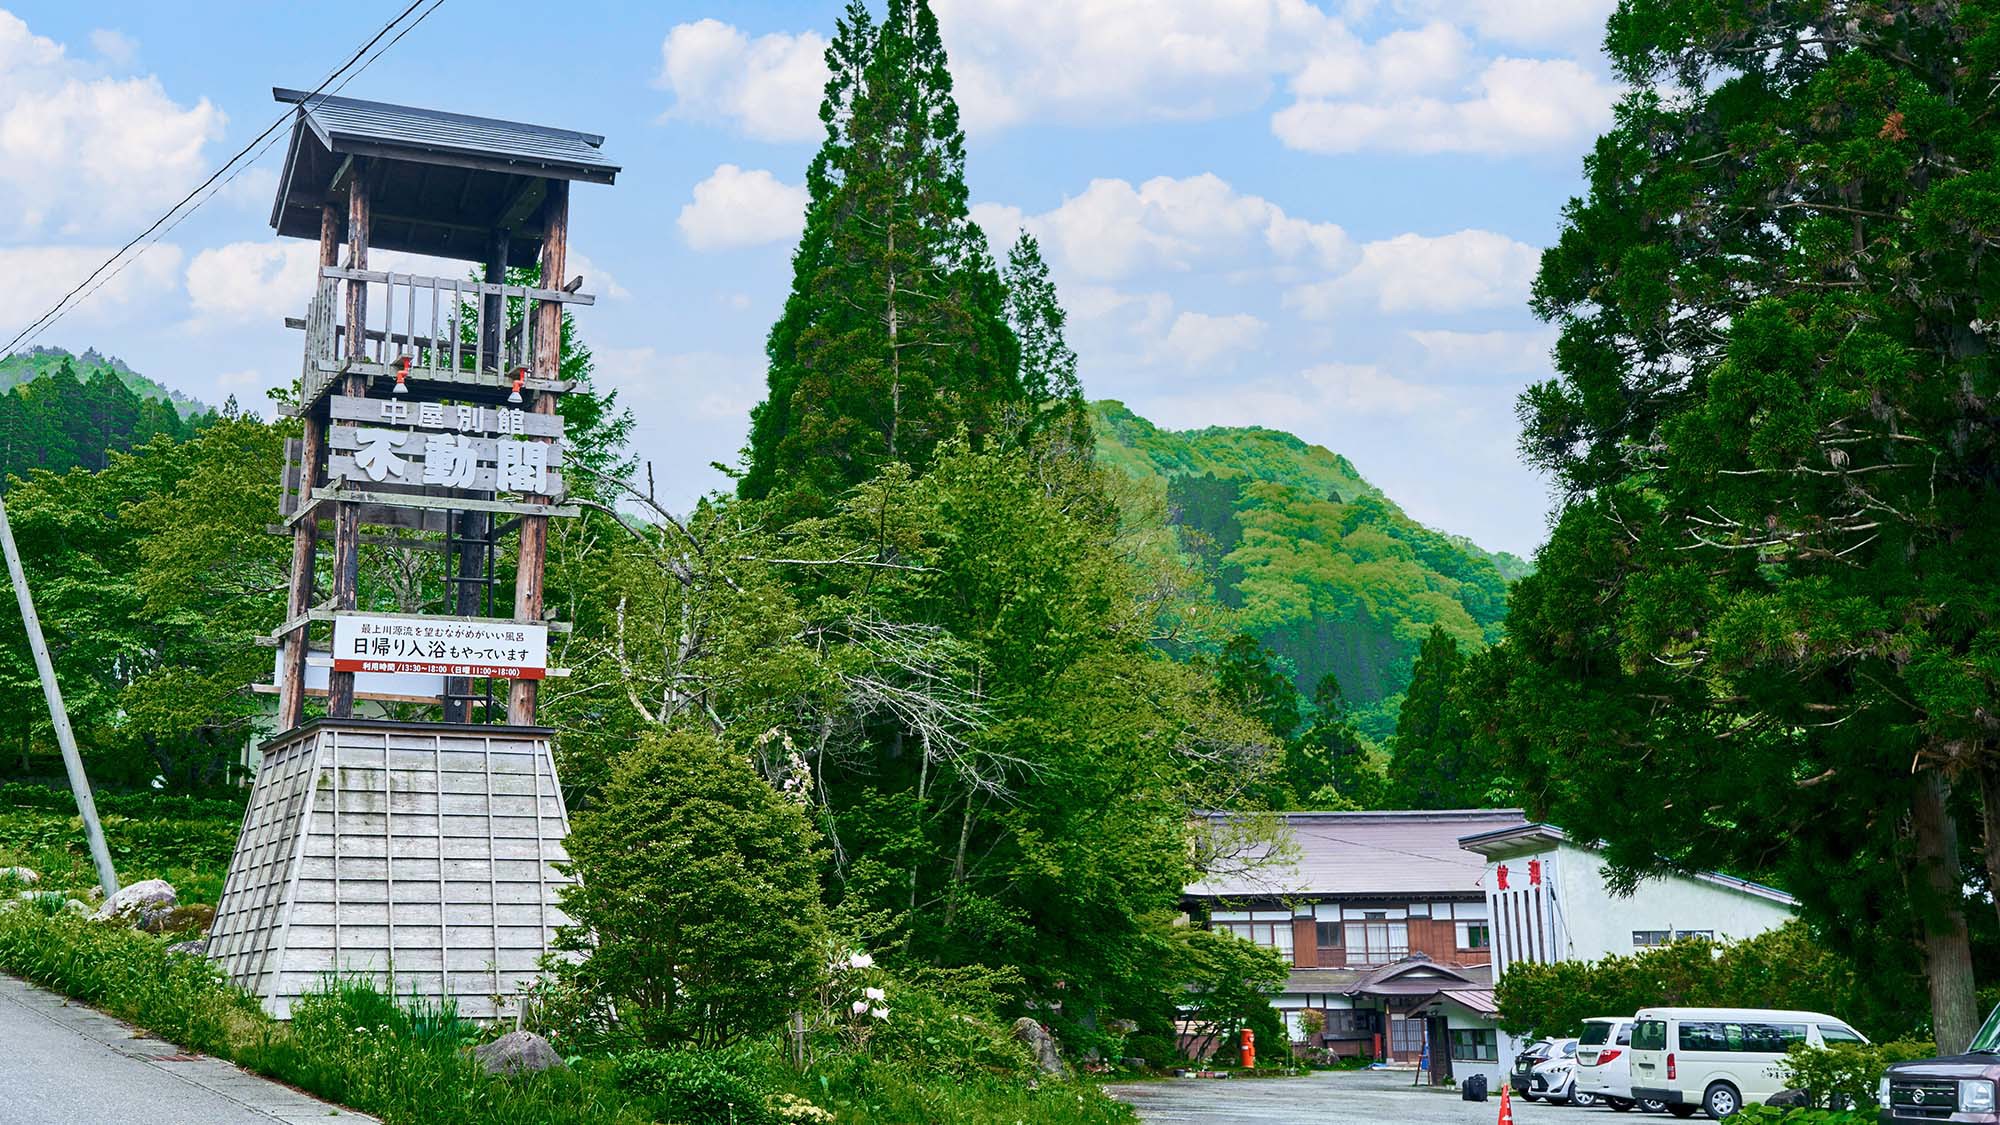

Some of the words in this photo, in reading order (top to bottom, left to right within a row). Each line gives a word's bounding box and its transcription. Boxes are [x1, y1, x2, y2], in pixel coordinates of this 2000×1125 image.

[381, 397, 525, 435] 中屋別館
[354, 428, 549, 494] 不動閣
[361, 623, 525, 641] 最上川源流を望むながめがいい風呂
[354, 637, 529, 662] 日帰り入浴もやっています
